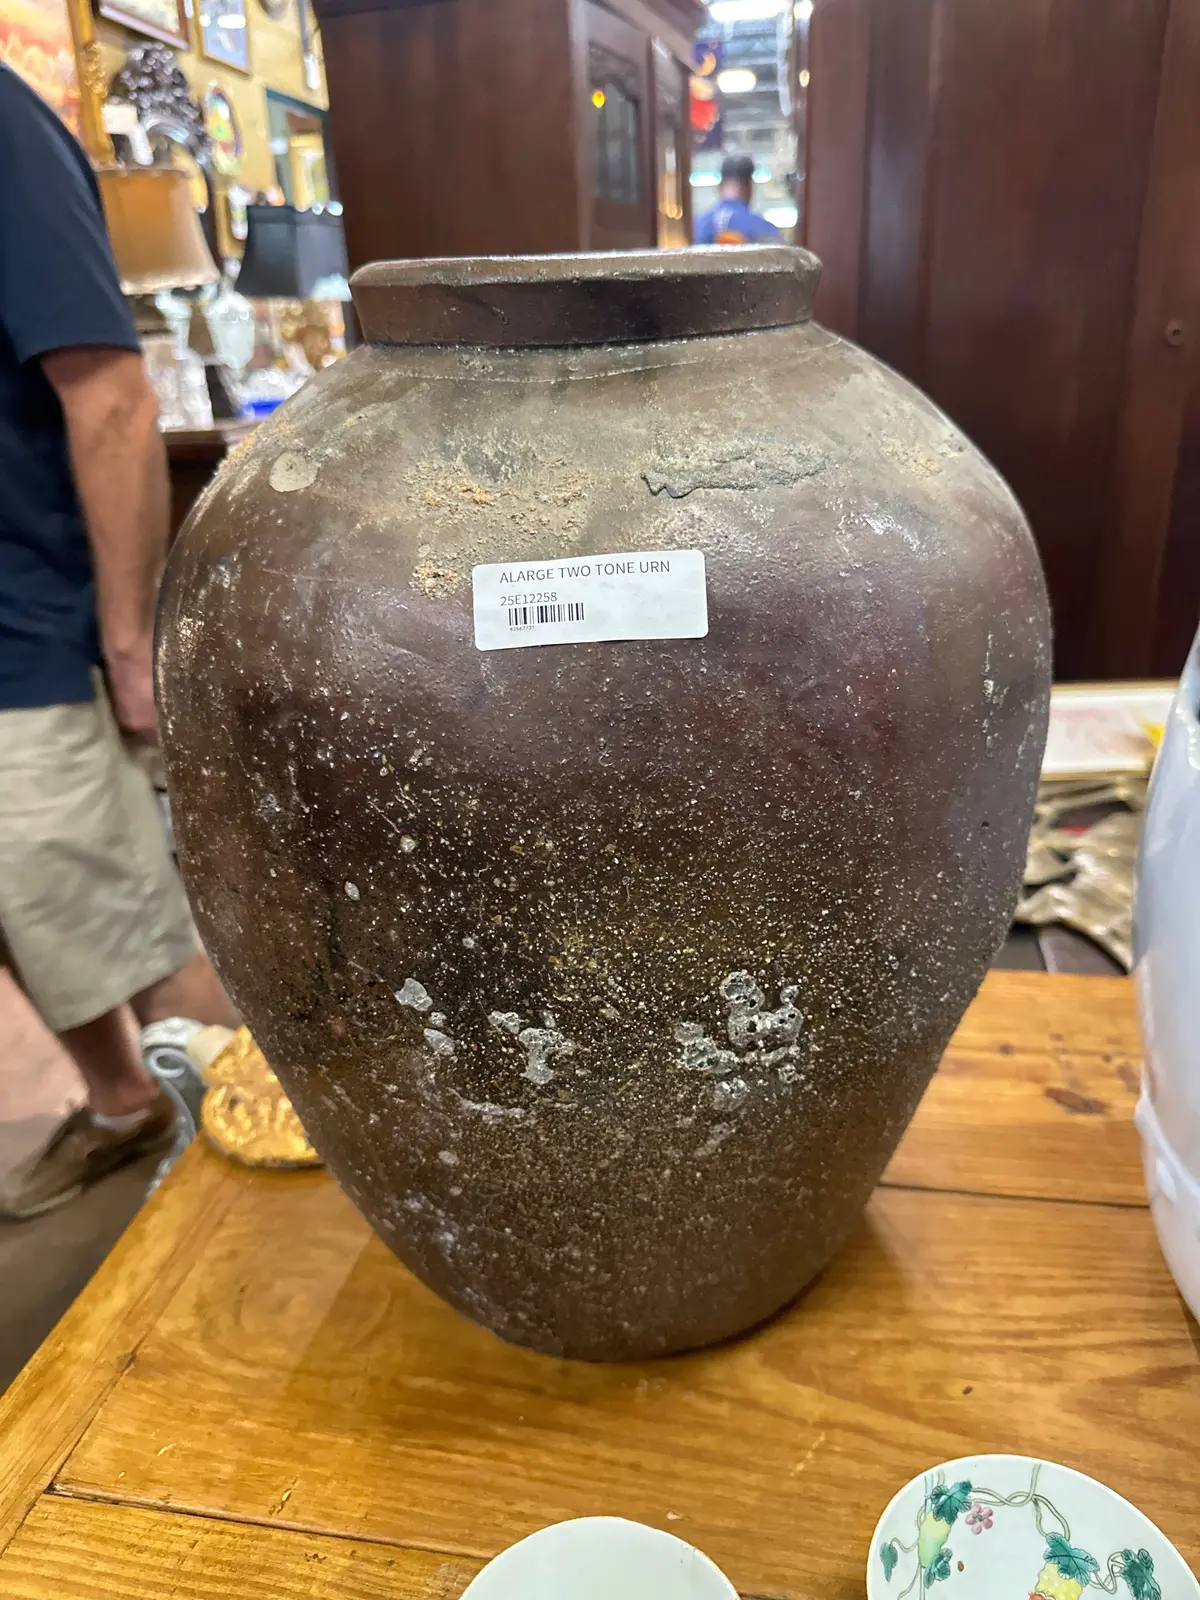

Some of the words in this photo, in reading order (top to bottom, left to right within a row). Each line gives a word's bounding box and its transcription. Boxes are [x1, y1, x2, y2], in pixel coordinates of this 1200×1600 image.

[558, 564, 592, 579] TWO
[595, 561, 636, 576] TONE
[639, 560, 671, 574] URN
[500, 592, 558, 607] 25E12258
